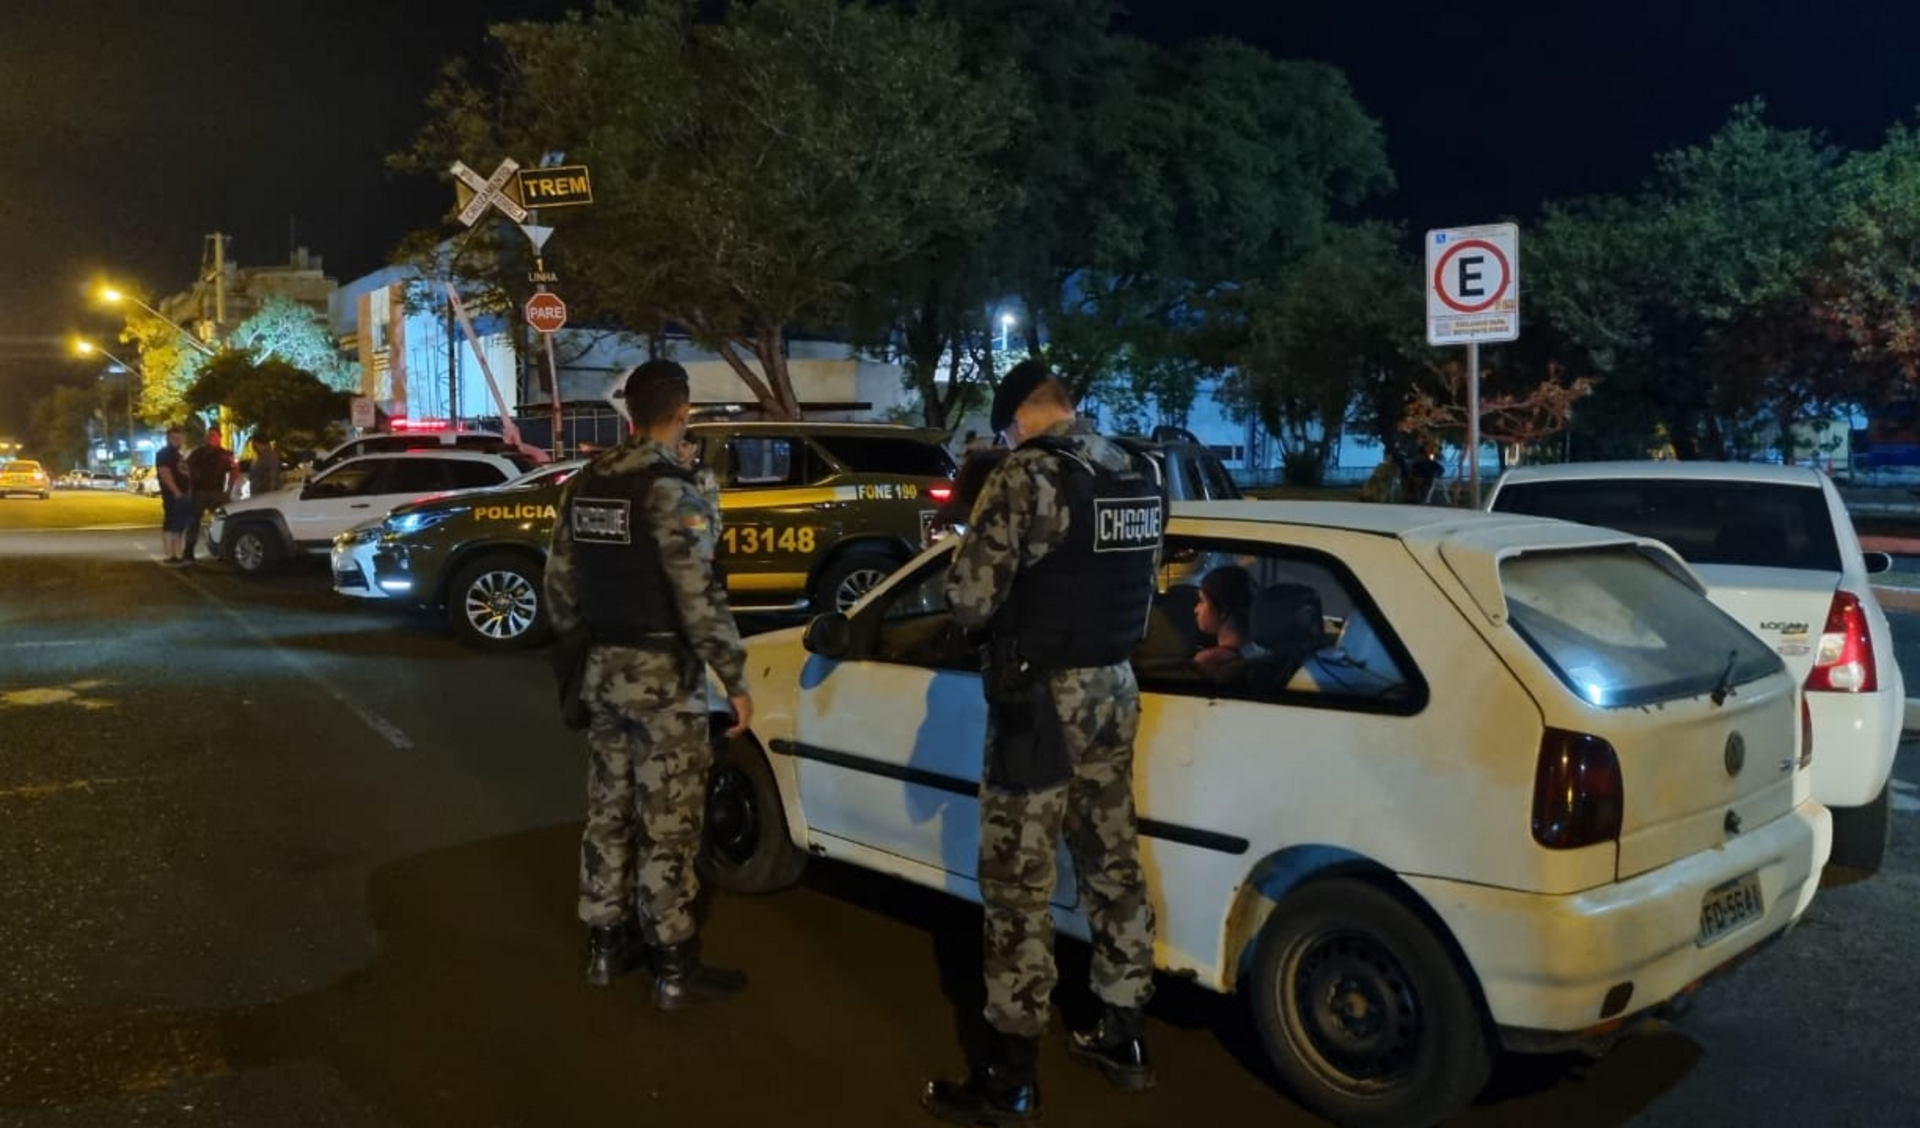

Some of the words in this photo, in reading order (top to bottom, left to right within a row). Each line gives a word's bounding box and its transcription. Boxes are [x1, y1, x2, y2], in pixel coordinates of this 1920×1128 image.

[466, 166, 512, 220] CRUZAMENTO
[524, 175, 587, 198] TREM
[536, 258, 544, 271] 1
[528, 271, 558, 282] LINHA
[1458, 256, 1484, 297] E
[529, 306, 564, 320] PARE
[858, 484, 893, 500] FONE
[894, 483, 918, 499] 190
[474, 503, 558, 521] POLÍCIA
[1099, 507, 1159, 544] CHOQUE
[722, 527, 816, 554] 13148
